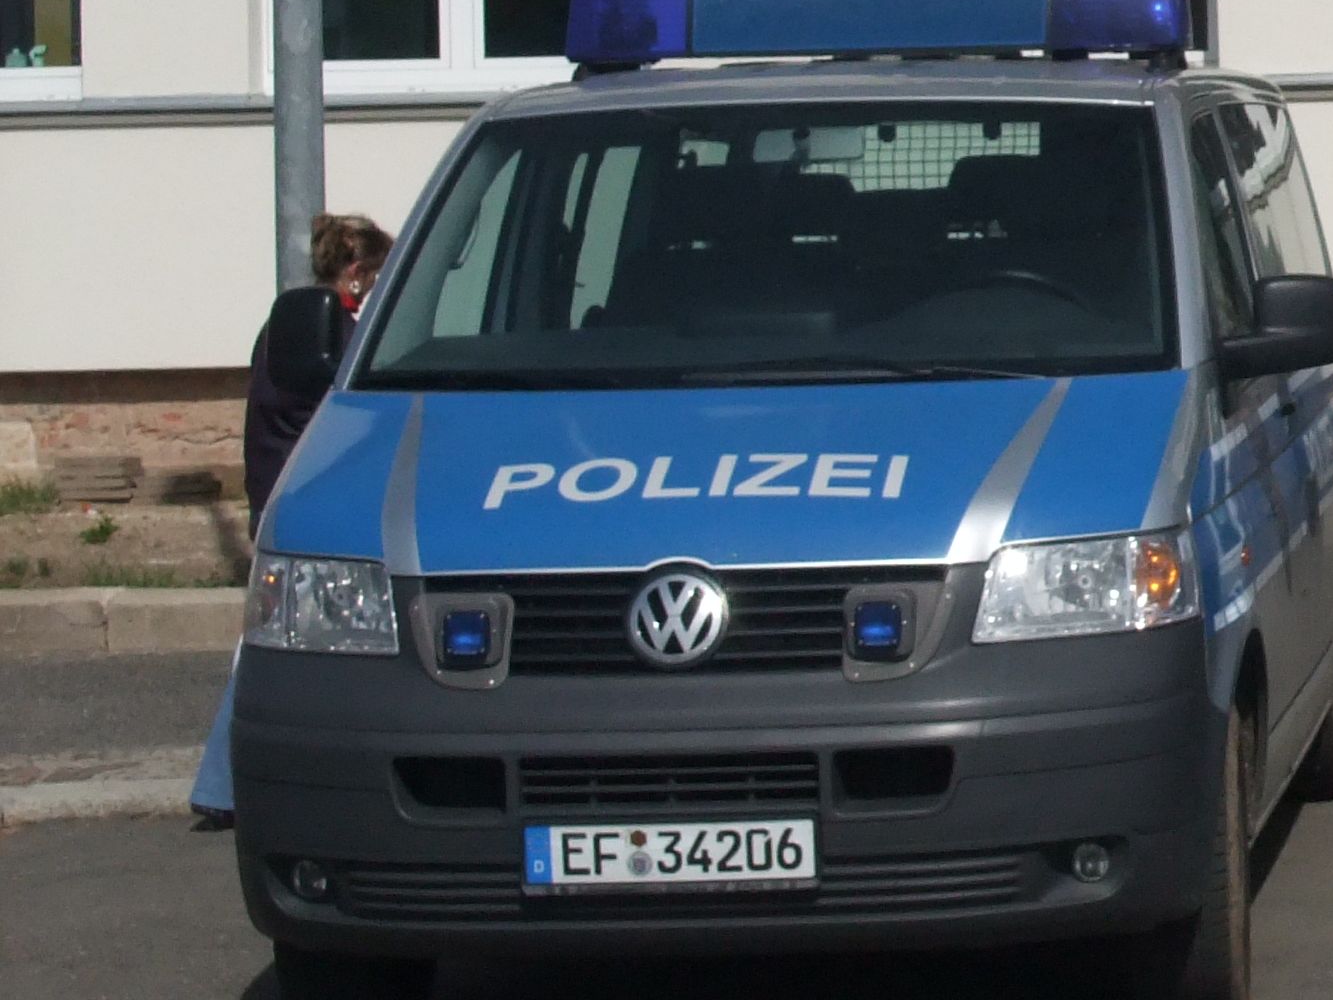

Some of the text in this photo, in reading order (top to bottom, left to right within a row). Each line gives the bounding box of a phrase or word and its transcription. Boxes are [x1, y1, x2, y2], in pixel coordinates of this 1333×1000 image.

[483, 453, 909, 511] POLIZEI
[561, 832, 620, 876] EF
[656, 826, 804, 875] 34206
